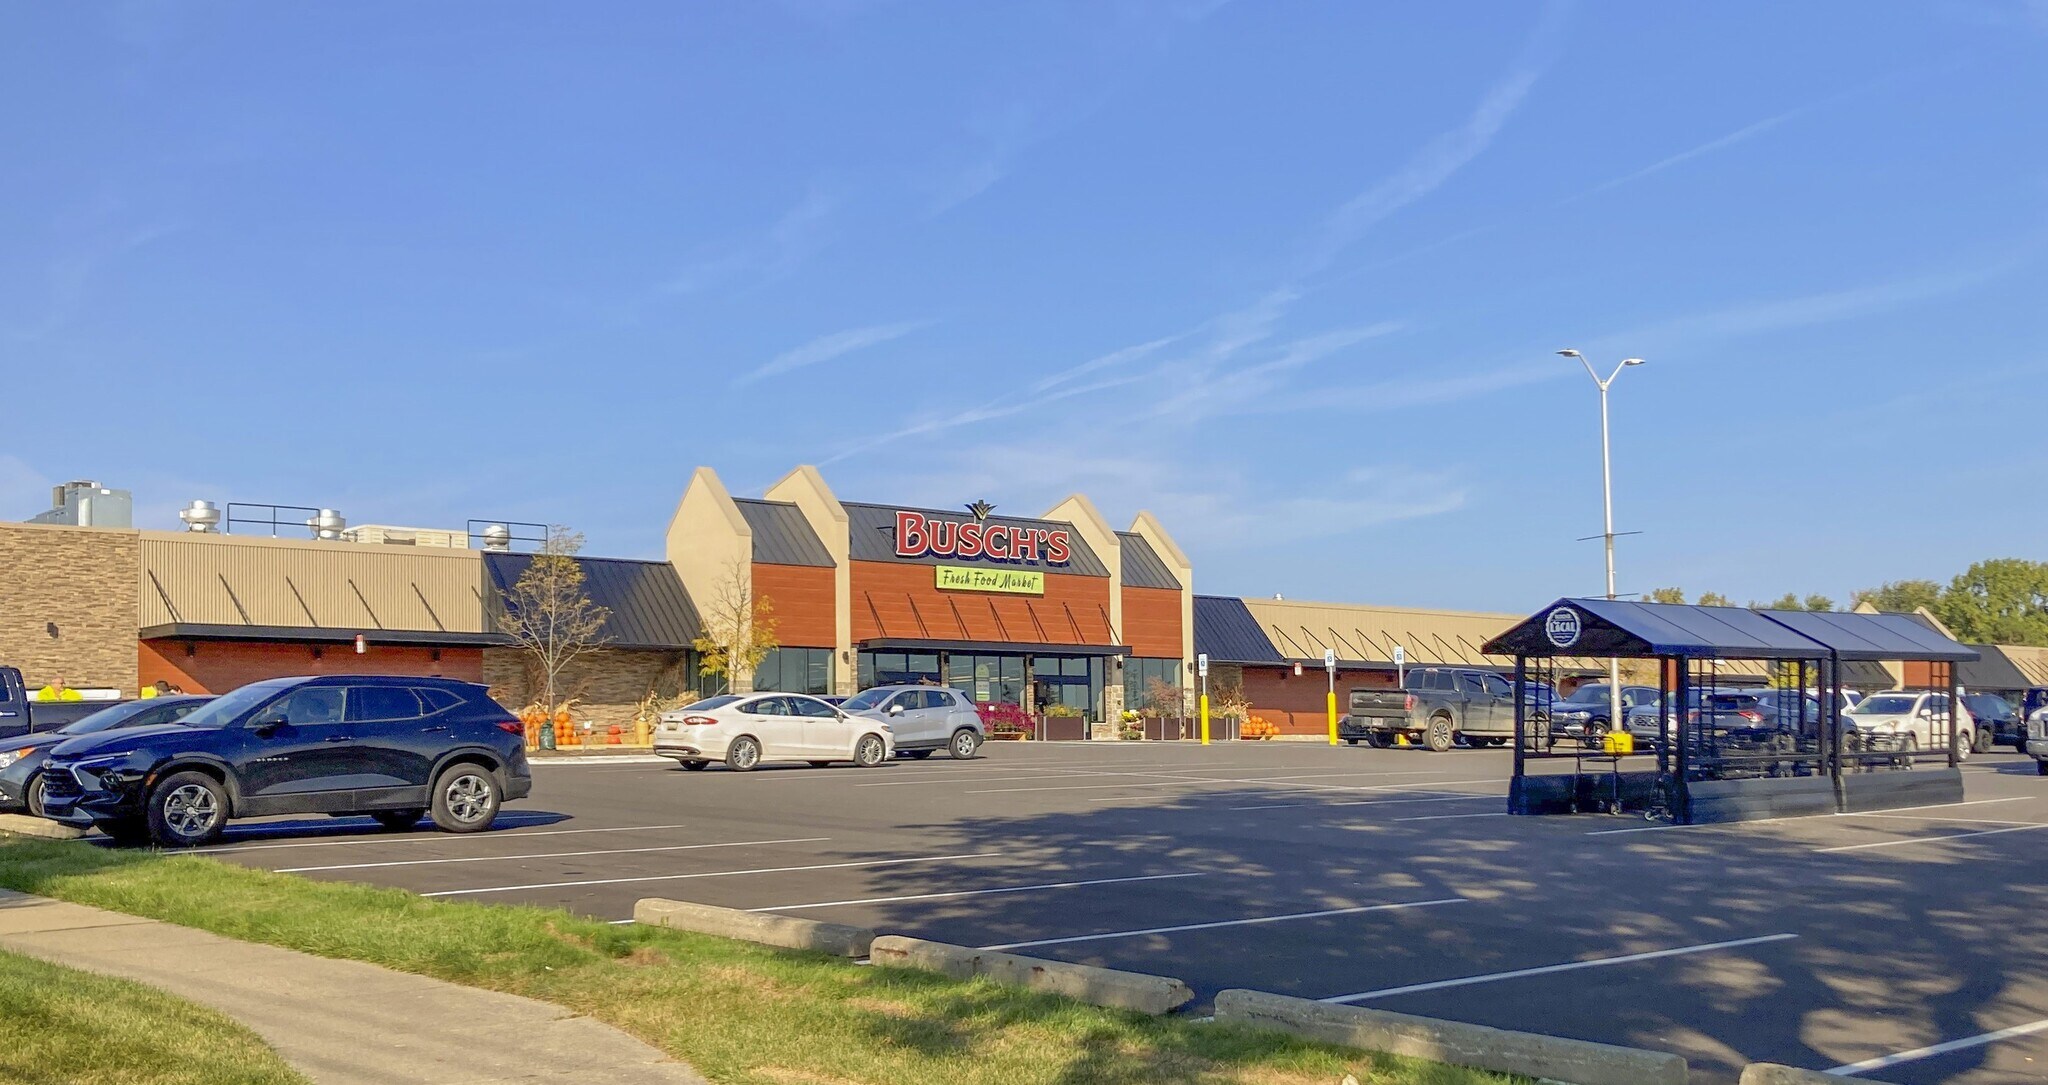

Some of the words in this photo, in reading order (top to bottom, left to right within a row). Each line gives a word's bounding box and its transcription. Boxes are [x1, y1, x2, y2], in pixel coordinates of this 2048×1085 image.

[895, 510, 1071, 564] BUSCH'S
[943, 569, 970, 585] Fresh
[974, 571, 998, 587] Food
[999, 573, 1038, 590] Market
